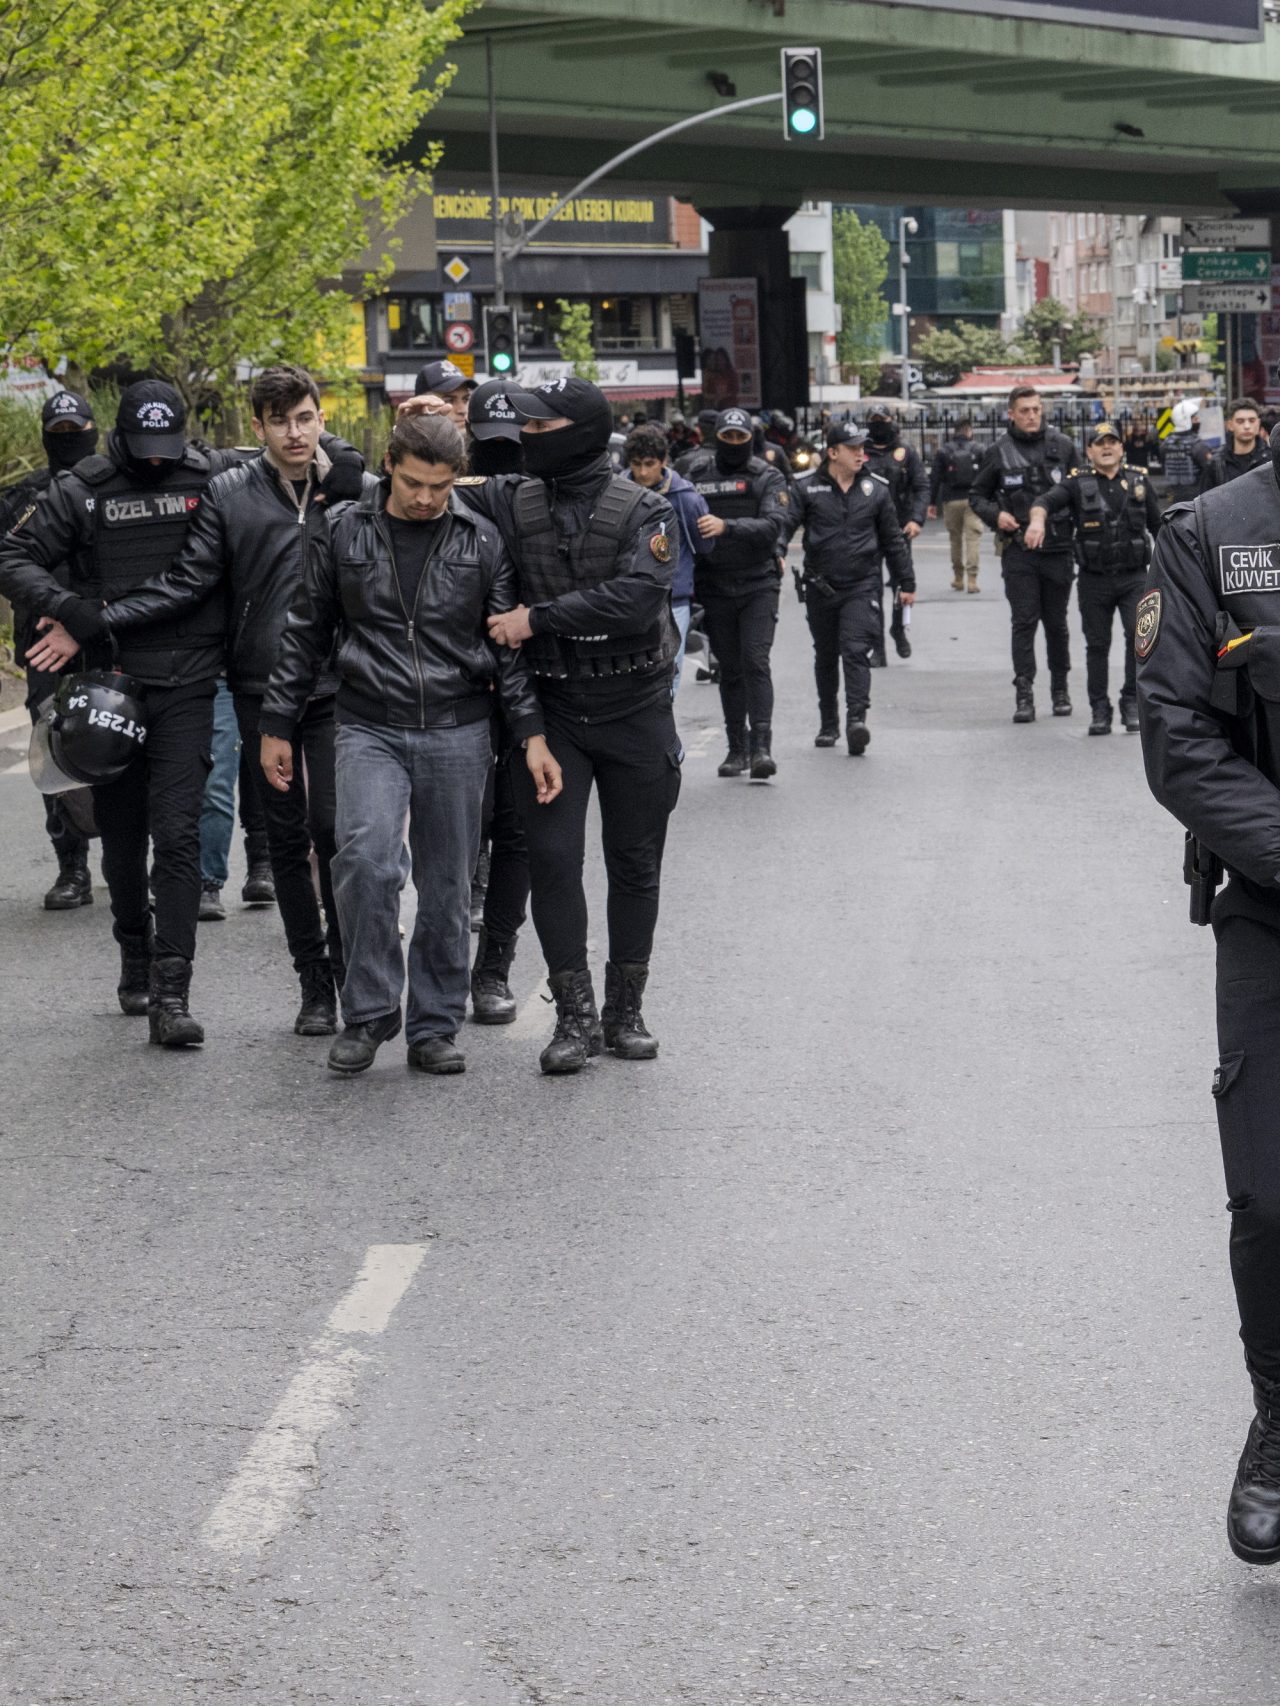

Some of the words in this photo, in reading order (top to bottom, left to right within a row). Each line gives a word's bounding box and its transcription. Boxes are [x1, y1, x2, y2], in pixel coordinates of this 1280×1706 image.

[575, 199, 612, 221] VEREN
[614, 200, 654, 222] KURUM
[1198, 256, 1239, 266] Ankara
[1197, 286, 1255, 299] Gayrettepe
[104, 500, 153, 522] ÖZEL
[154, 494, 187, 515] TİM
[1230, 548, 1273, 571] ÇEVİK
[1225, 569, 1280, 590] KUVVET
[68, 694, 88, 710] 34
